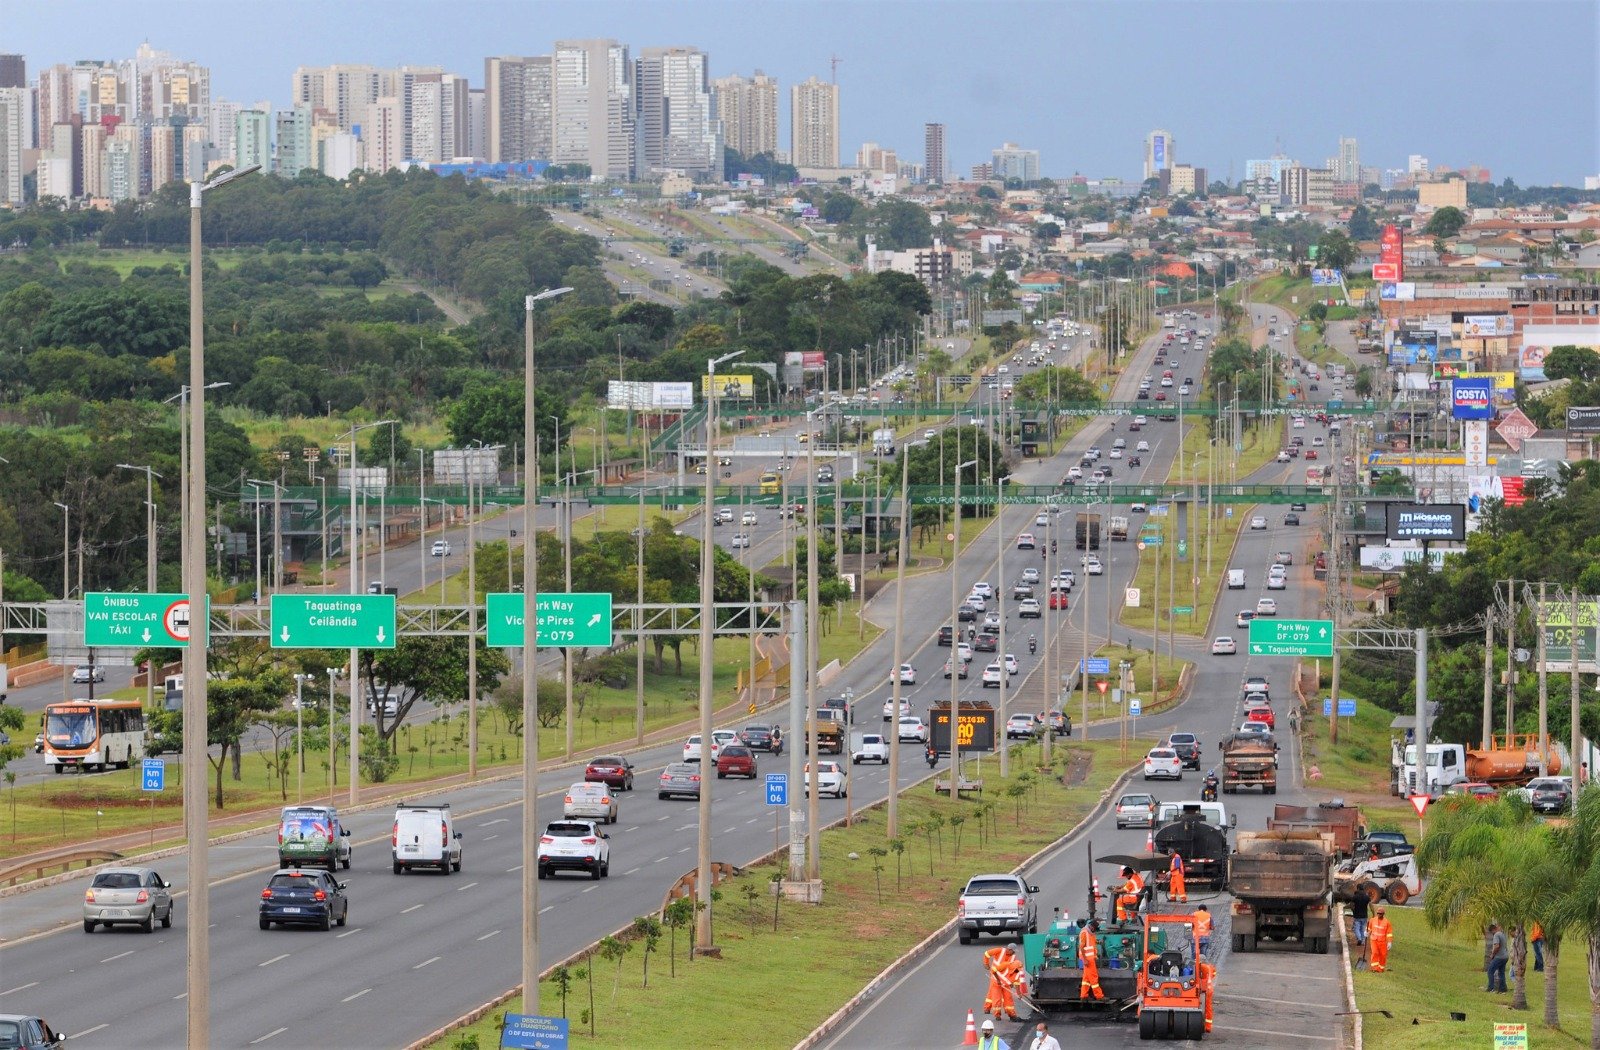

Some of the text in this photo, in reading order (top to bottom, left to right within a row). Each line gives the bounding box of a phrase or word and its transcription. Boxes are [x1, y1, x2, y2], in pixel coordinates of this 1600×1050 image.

[1456, 389, 1487, 400] COSTA
[103, 596, 139, 607] ÔNIBUS
[304, 600, 362, 613] Taguatinga
[535, 601, 574, 612] ark Way
[88, 612, 157, 622] VAN ESCOLAR
[309, 616, 357, 626] Ceilândia
[547, 615, 574, 626] Pires
[109, 624, 131, 634] TÁXI
[1277, 623, 1310, 632] Park Way
[1268, 645, 1307, 654] Taguatinga
[957, 716, 986, 724] IRIGIR
[147, 769, 160, 777] km
[147, 780, 159, 788] 06
[770, 784, 783, 792] km
[770, 794, 782, 803] 06
[520, 1023, 559, 1031] TRANSTORNO
